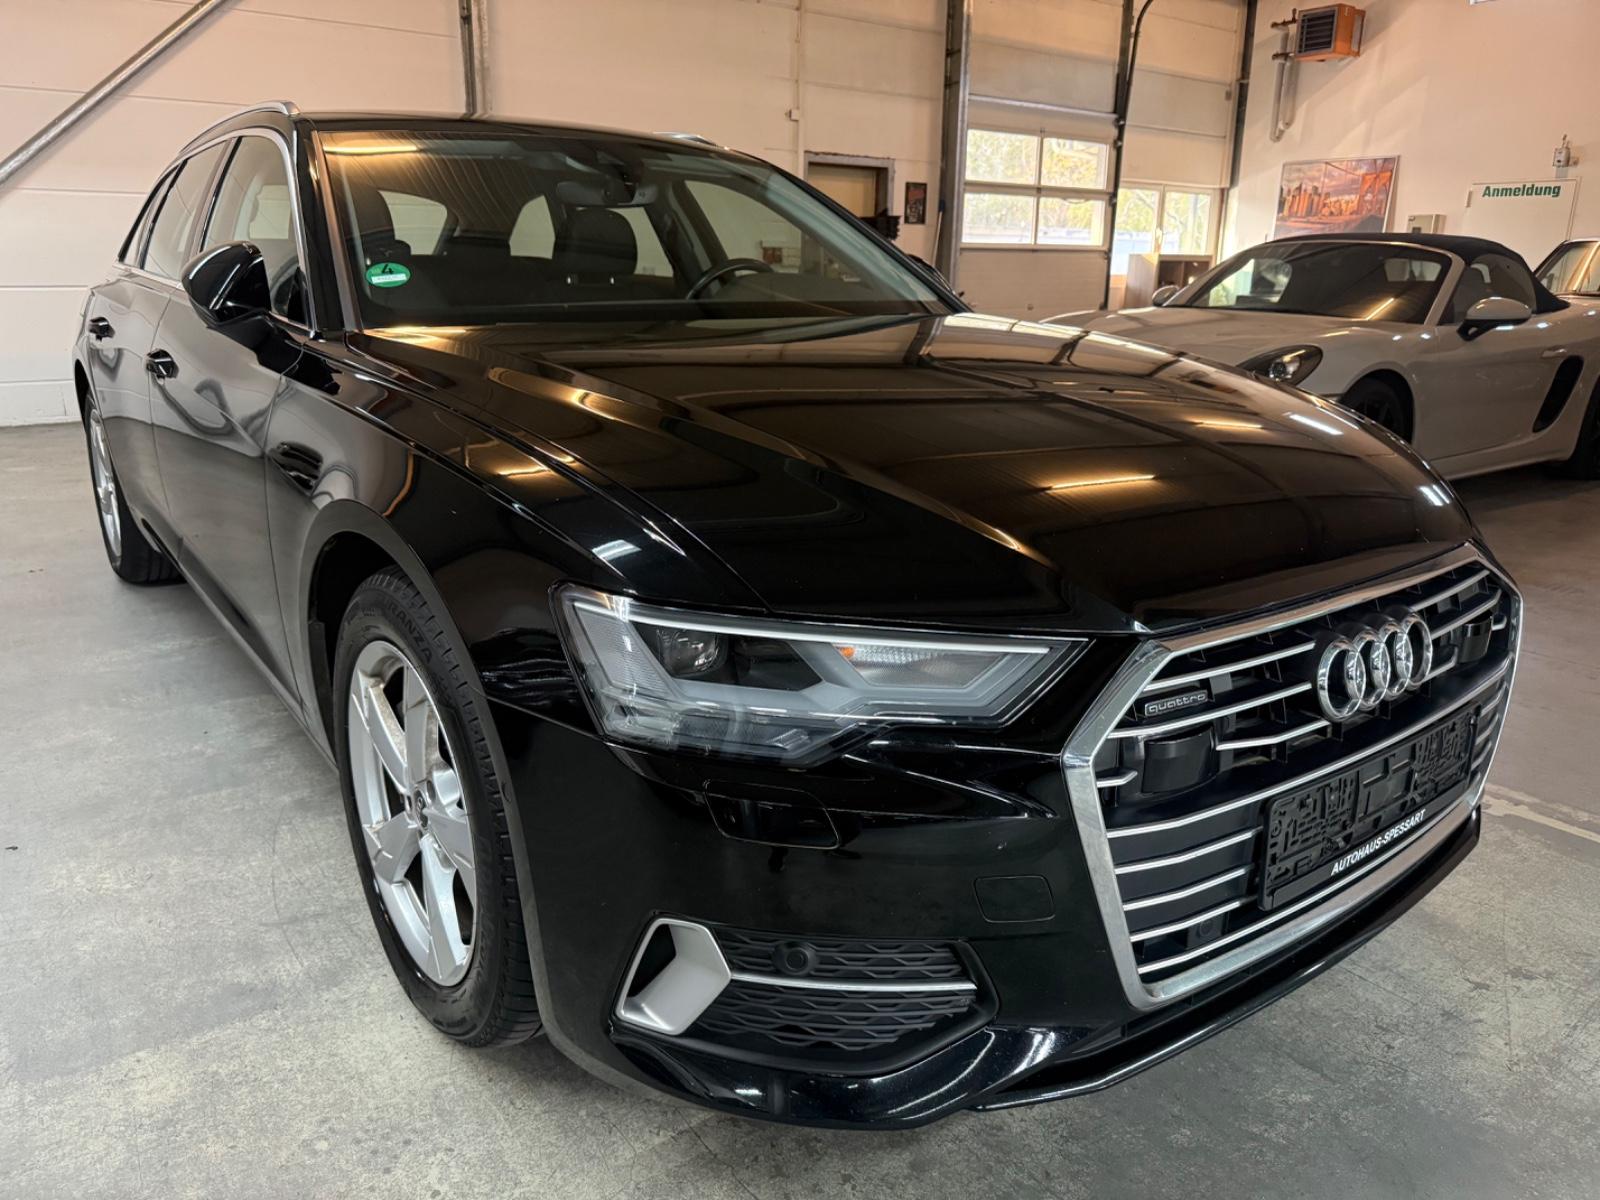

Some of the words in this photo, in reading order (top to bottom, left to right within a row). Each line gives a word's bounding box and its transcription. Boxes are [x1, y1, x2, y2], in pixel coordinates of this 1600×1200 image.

[1482, 183, 1561, 198] Anmeldung
[1148, 692, 1206, 713] quattro
[1331, 809, 1426, 876] AUTOHAUS-SPESSART
